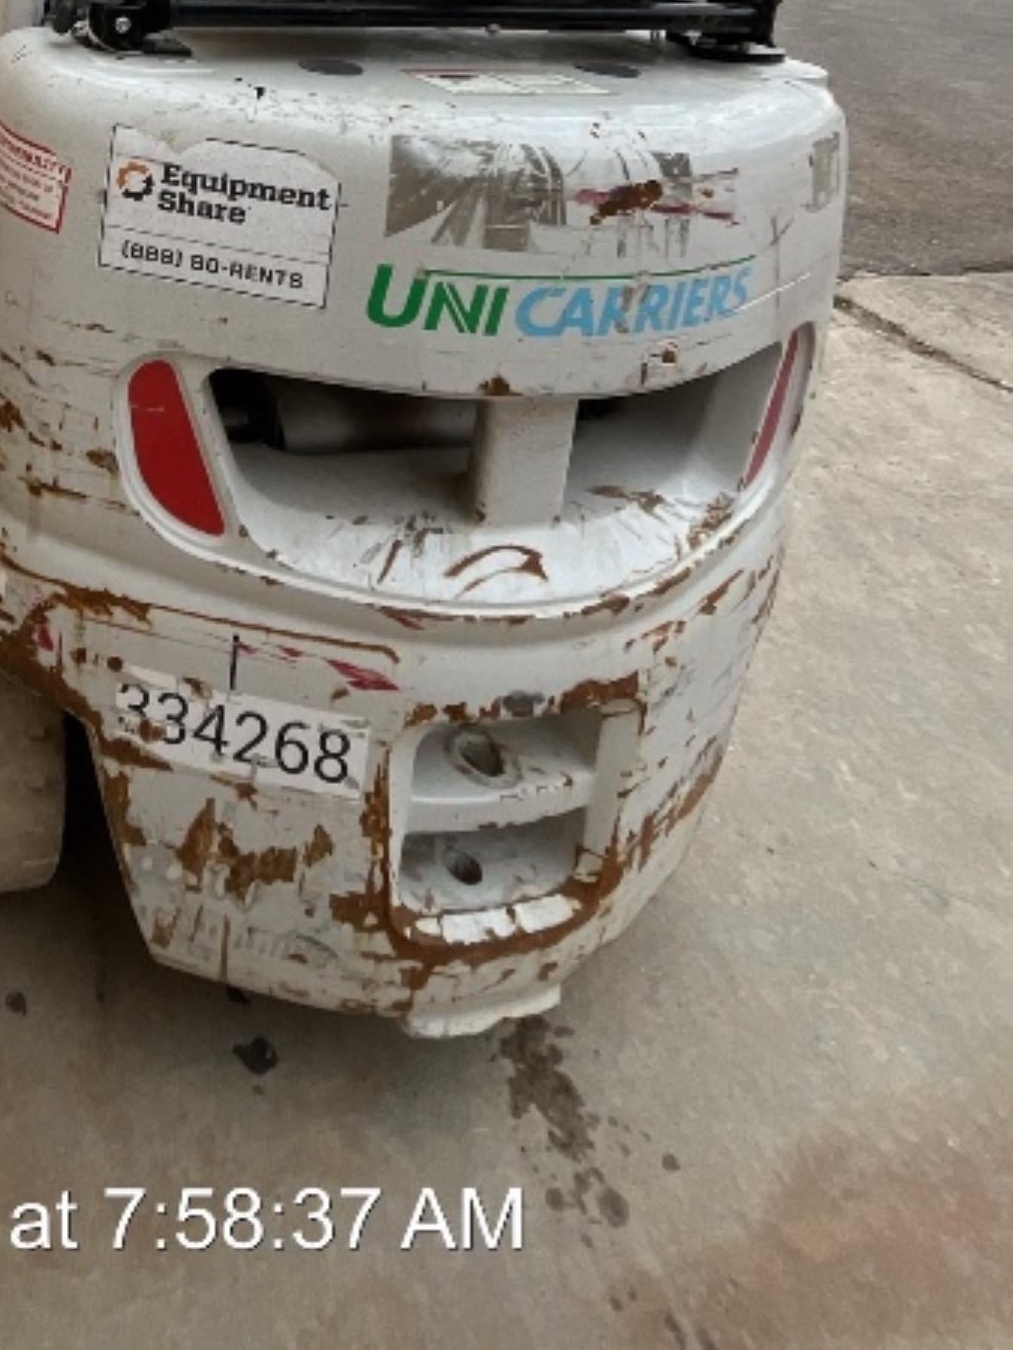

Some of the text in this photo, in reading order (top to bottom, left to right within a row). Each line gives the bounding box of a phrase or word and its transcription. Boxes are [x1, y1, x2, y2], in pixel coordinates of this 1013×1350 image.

[161, 163, 331, 210] Equipment
[158, 190, 246, 224] Share
[121, 240, 183, 267] (888)
[117, 683, 351, 784] 334268
